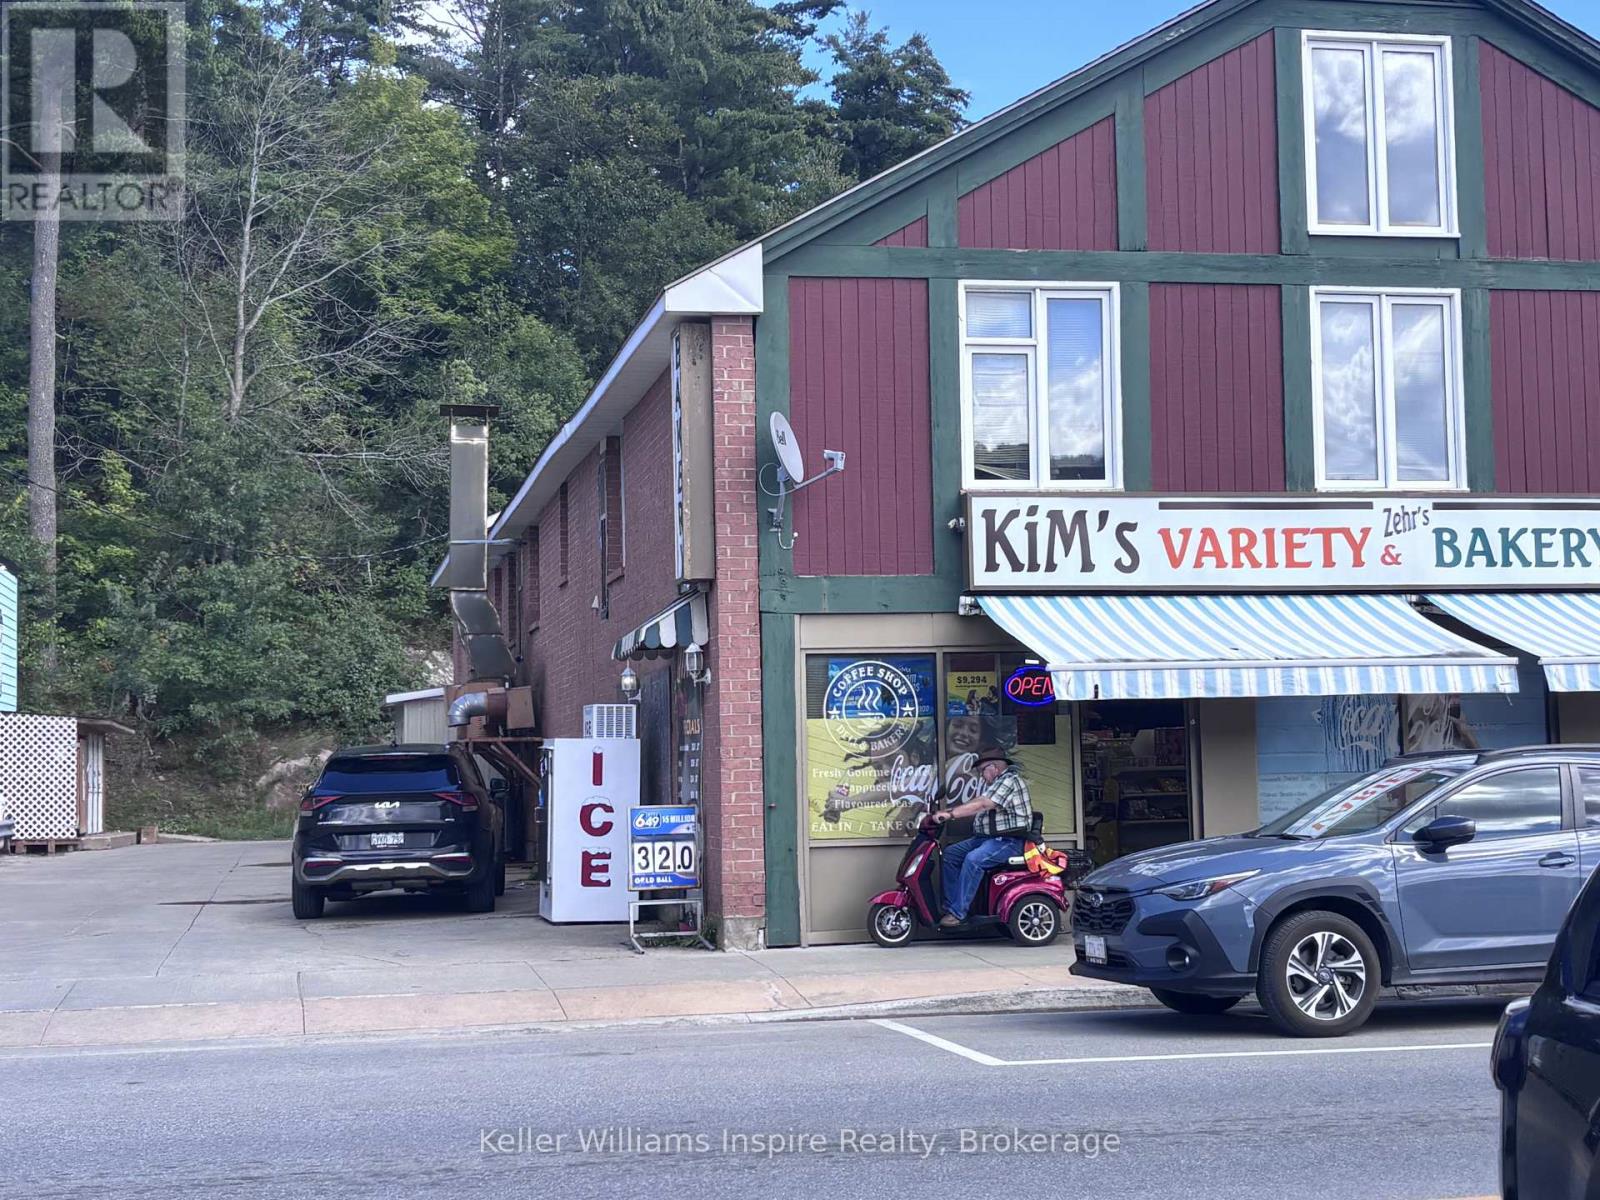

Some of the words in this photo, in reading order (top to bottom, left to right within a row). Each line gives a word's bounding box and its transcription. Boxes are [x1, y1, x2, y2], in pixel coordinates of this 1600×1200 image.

[1383, 505, 1430, 537] Zehr's
[1157, 526, 1372, 570] VARIETY
[1380, 544, 1402, 566] &
[832, 666, 875, 698] COFFEE
[877, 668, 908, 697] SHOP
[870, 722, 911, 752] BAKERY
[812, 768, 842, 778] Fresh
[847, 768, 892, 778] Gourme
[579, 748, 615, 888] ICE
[834, 799, 887, 809] Flavoured
[869, 820, 903, 831] TAKE
